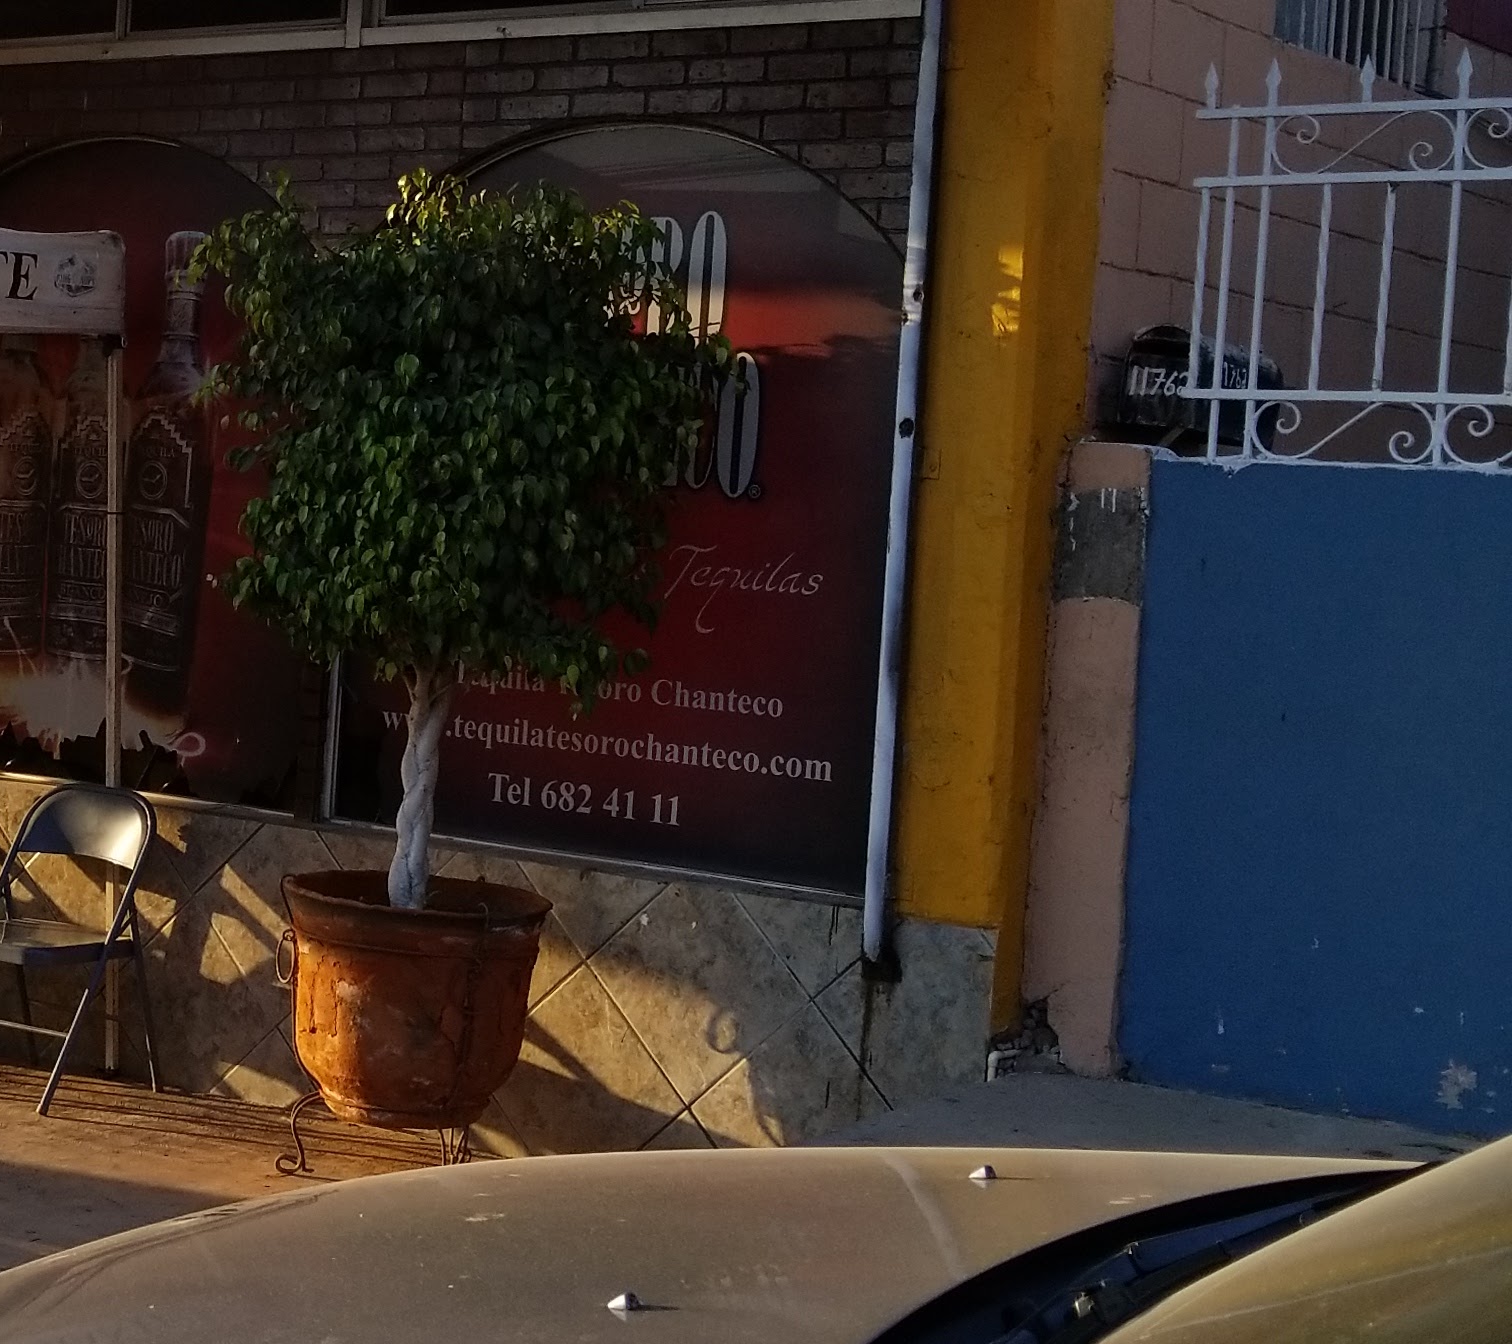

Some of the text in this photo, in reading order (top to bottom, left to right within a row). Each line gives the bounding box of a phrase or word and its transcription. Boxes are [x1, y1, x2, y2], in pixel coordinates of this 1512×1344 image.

[662, 543, 825, 635] Tequilas
[650, 677, 785, 720] Chanteco
[488, 772, 681, 827] Tel 682 41 11
